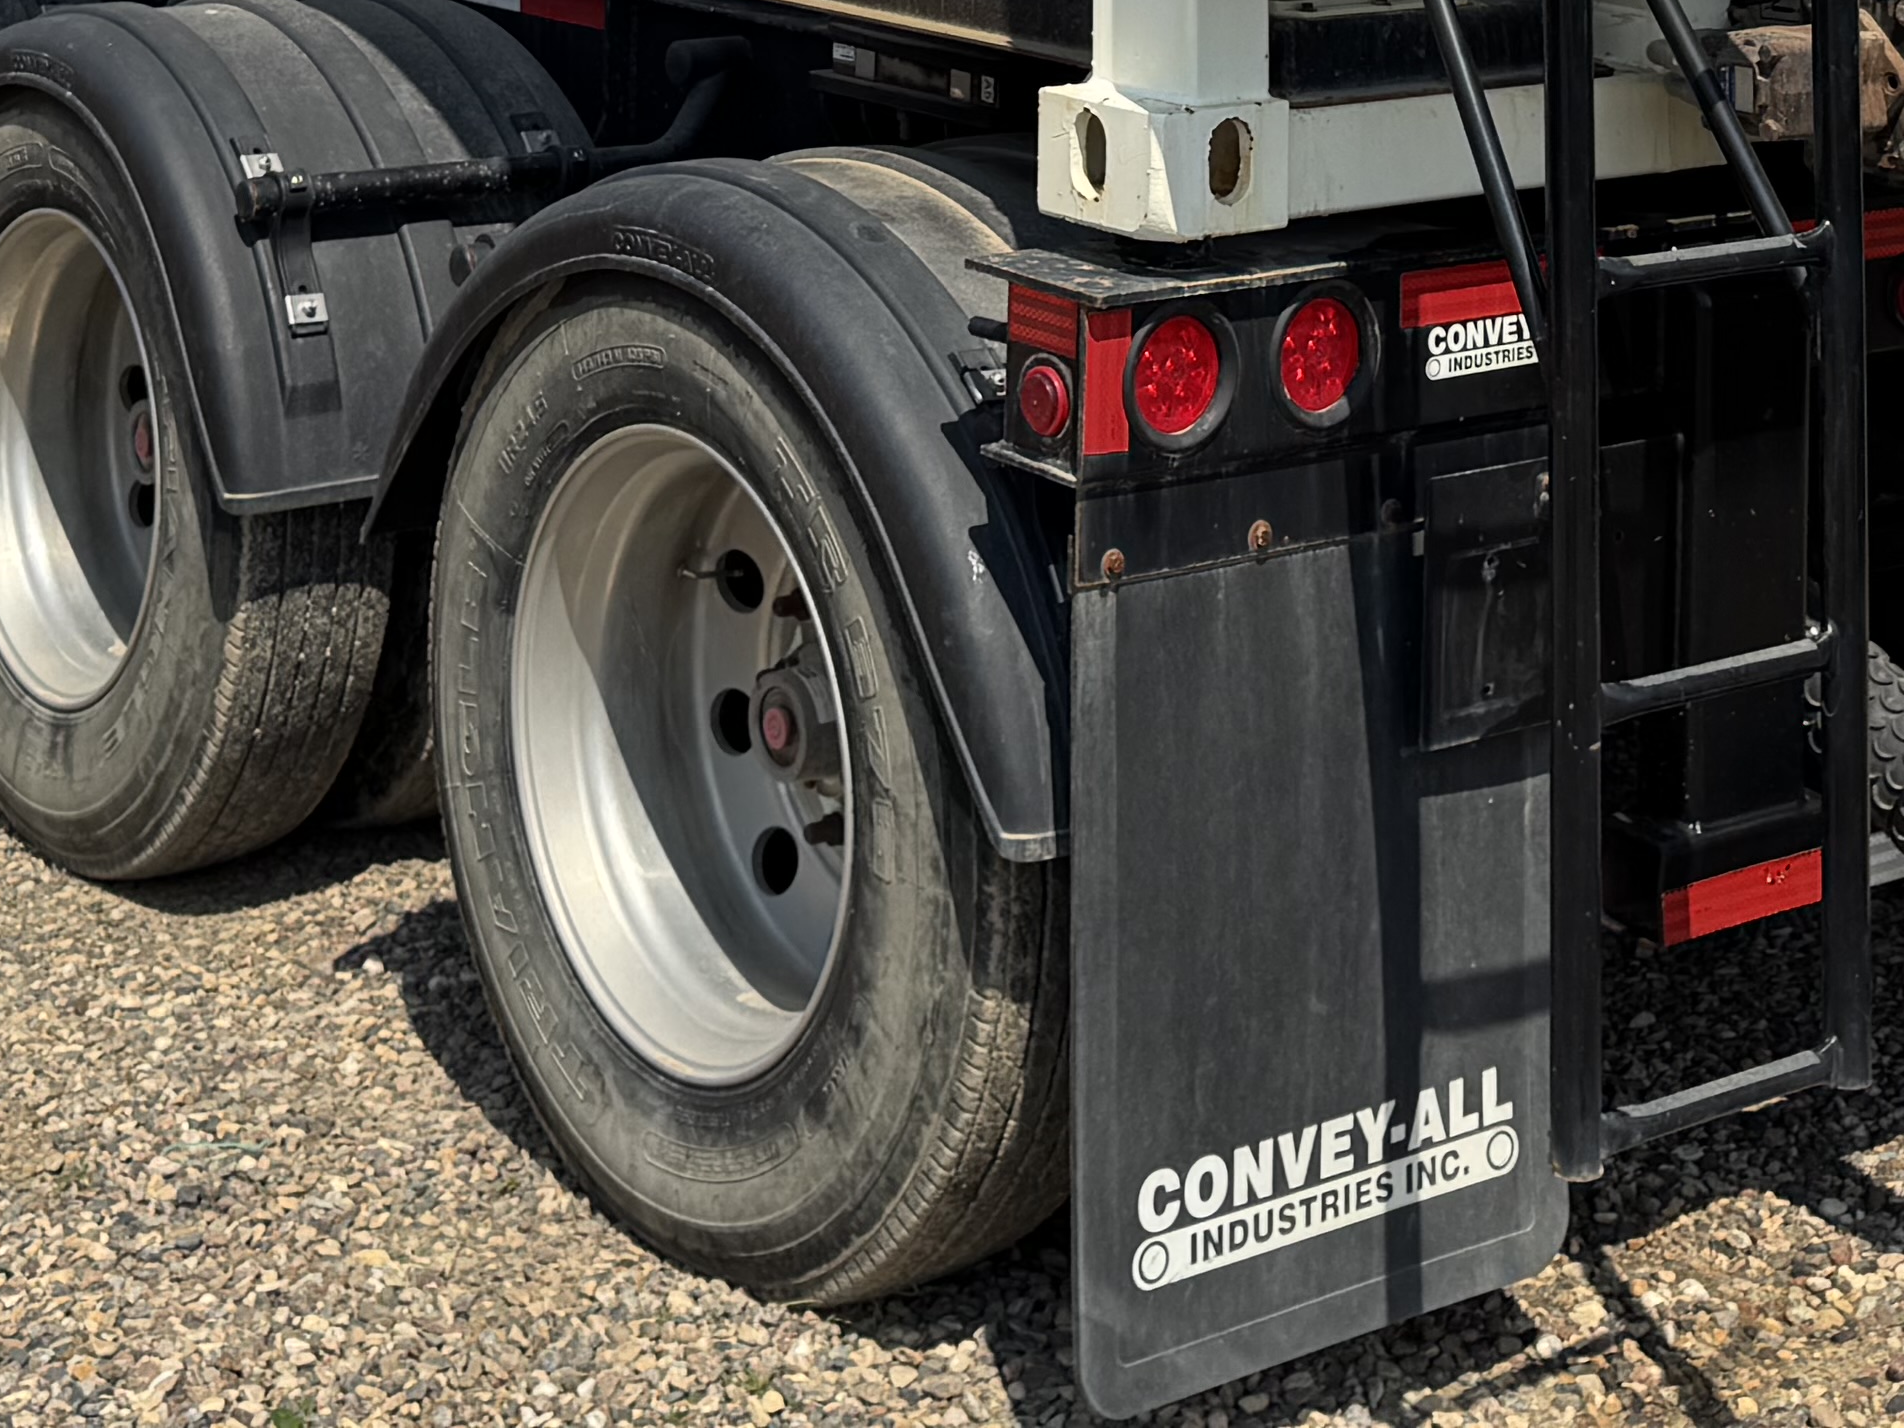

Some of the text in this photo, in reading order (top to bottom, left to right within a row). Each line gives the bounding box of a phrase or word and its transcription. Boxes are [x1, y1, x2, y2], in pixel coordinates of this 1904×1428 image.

[1448, 345, 1534, 373] INDUSTRIES
[1137, 1065, 1513, 1234] CONVEY-ALL
[1190, 1149, 1471, 1266] INDUSTRIES INC.
